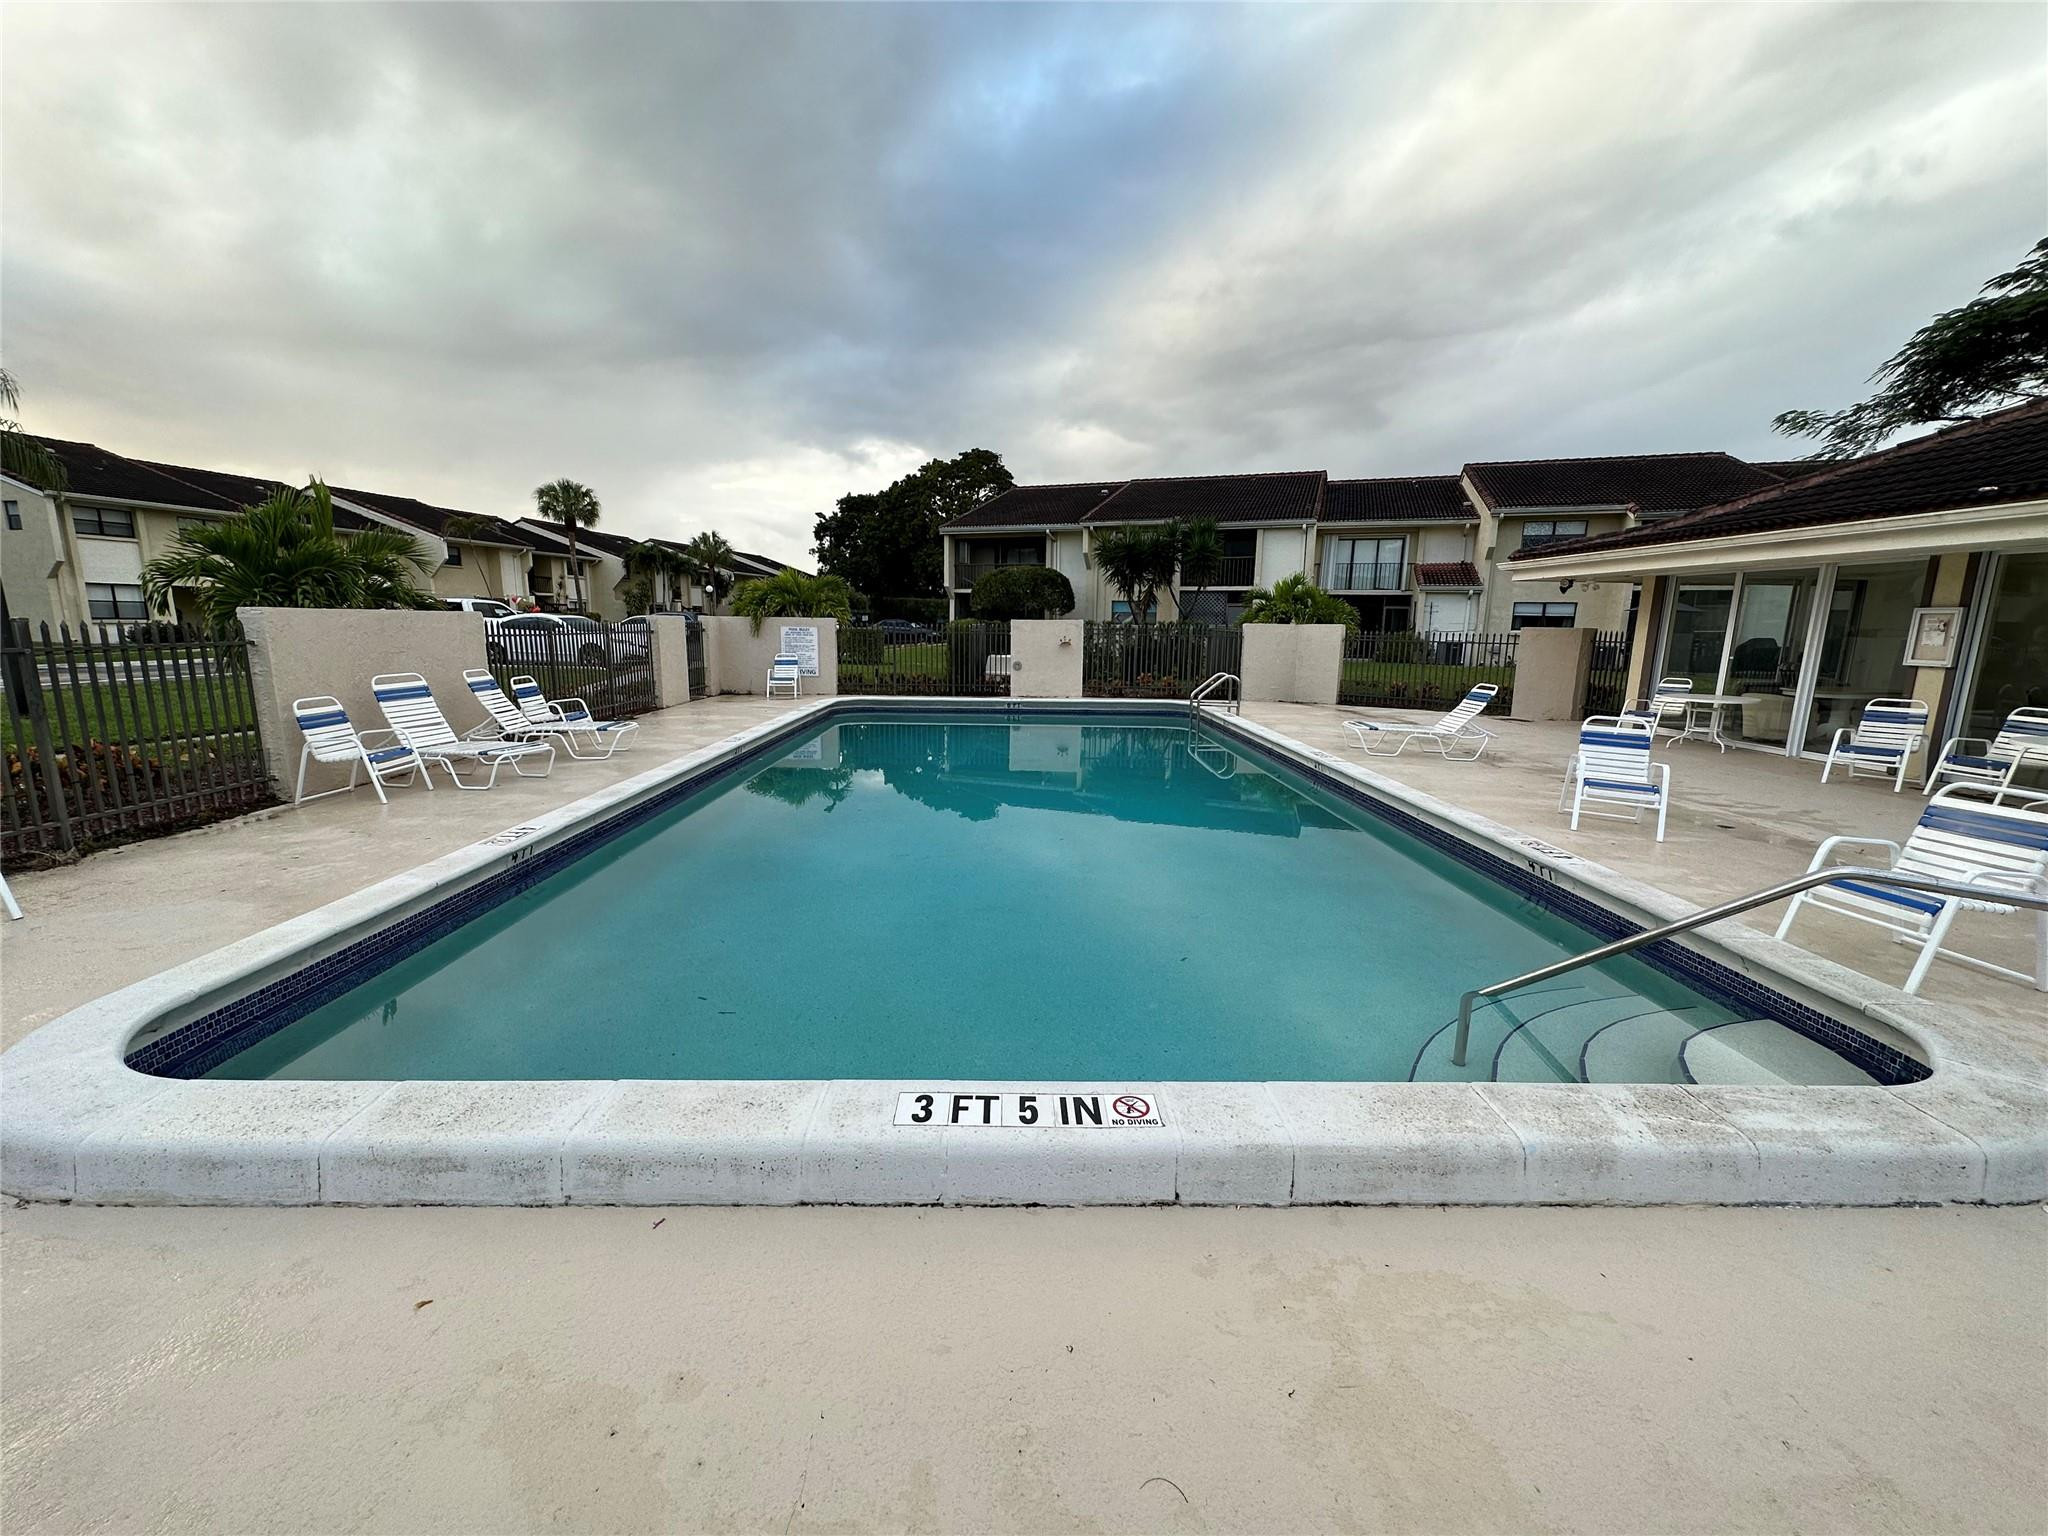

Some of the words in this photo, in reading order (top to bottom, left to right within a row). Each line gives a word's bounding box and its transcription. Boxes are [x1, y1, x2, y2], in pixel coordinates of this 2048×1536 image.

[911, 1094, 935, 1123] 3
[951, 1094, 1000, 1124] FT
[1018, 1096, 1039, 1125] 5
[1059, 1096, 1103, 1125] IN
[1111, 1118, 1126, 1126] NO
[1127, 1118, 1159, 1126] DIVING
